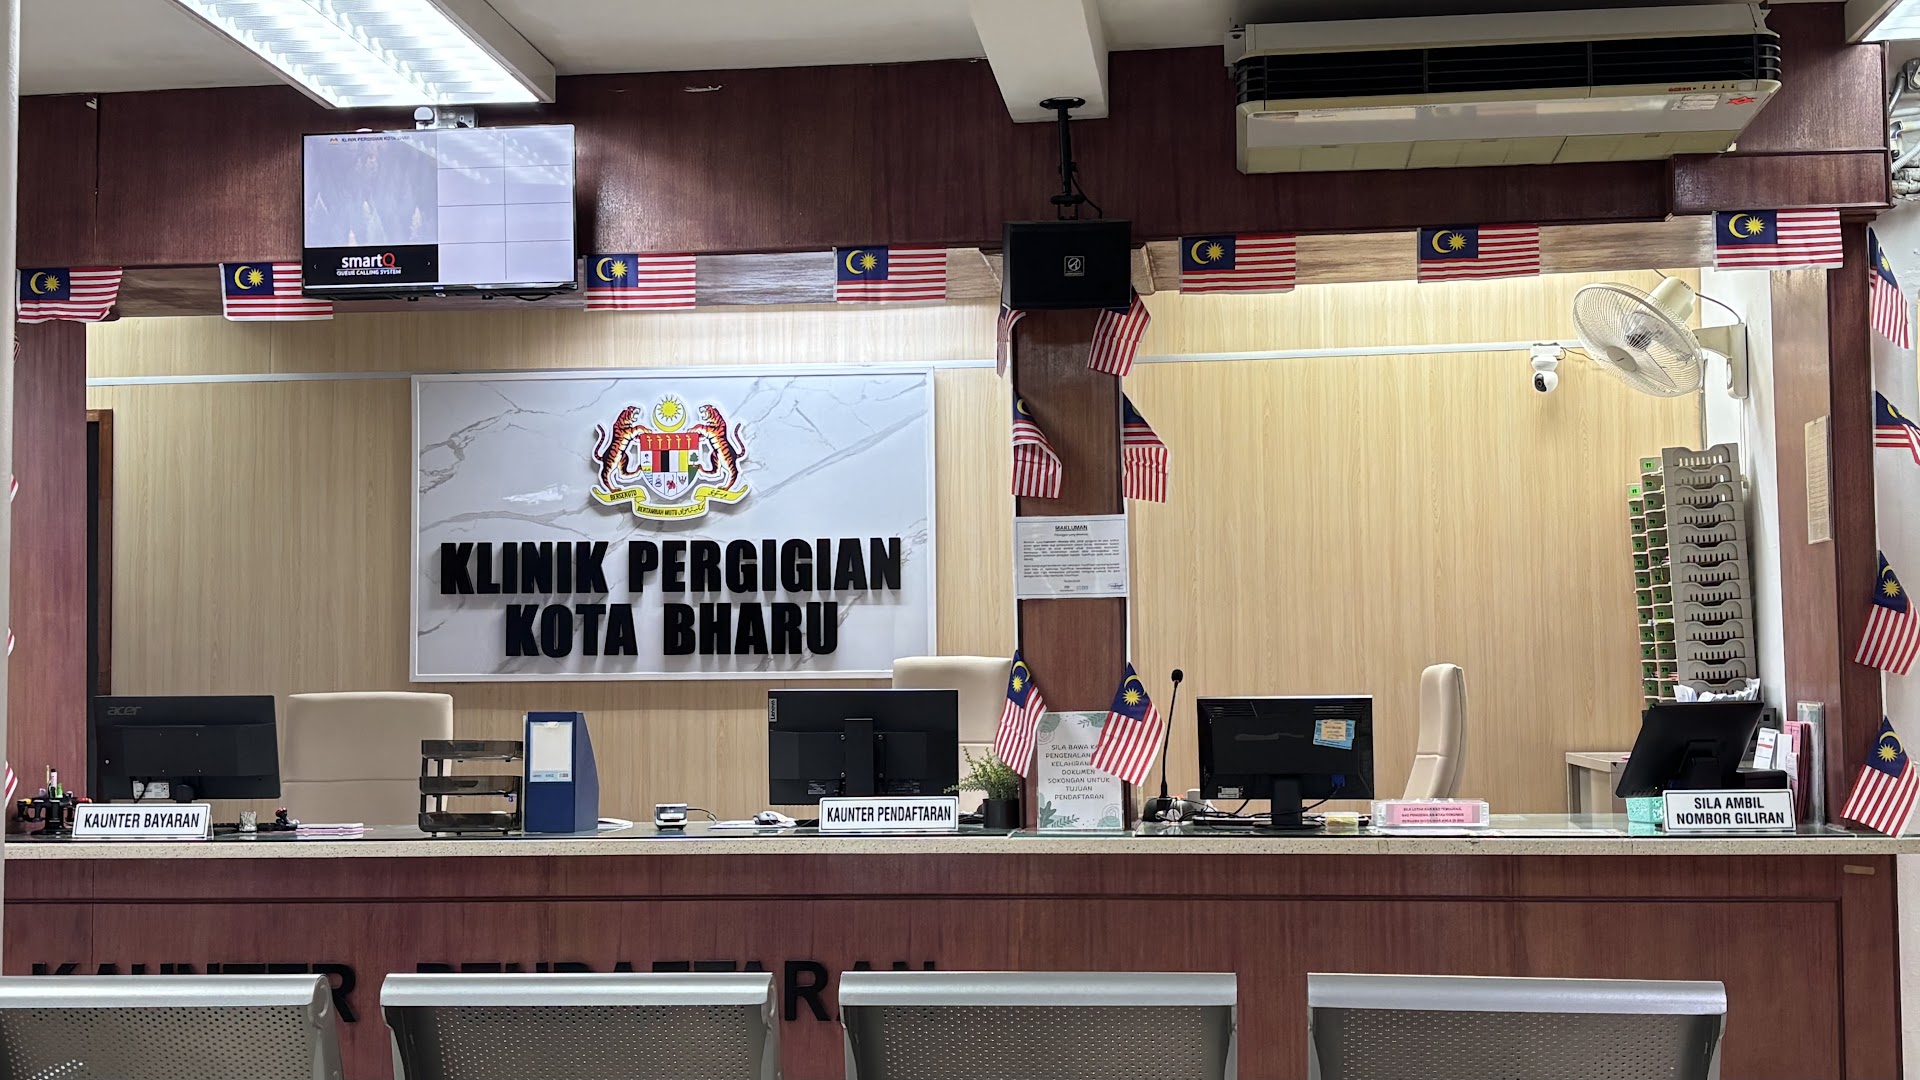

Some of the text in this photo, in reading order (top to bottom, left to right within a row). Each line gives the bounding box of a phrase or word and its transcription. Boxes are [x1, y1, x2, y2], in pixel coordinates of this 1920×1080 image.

[341, 252, 396, 268] smartQ
[440, 537, 901, 595] KLINIK PERGIGIAN
[505, 601, 838, 658] KOTA BHARU
[107, 706, 142, 716] acer
[1694, 797, 1764, 809] SILA AMBIL
[84, 812, 200, 828] KAUNTER BAYARAN
[827, 805, 951, 822] KAUNTER PENDAFTARAN
[1676, 811, 1784, 825] NOMBOR GILIRAN
